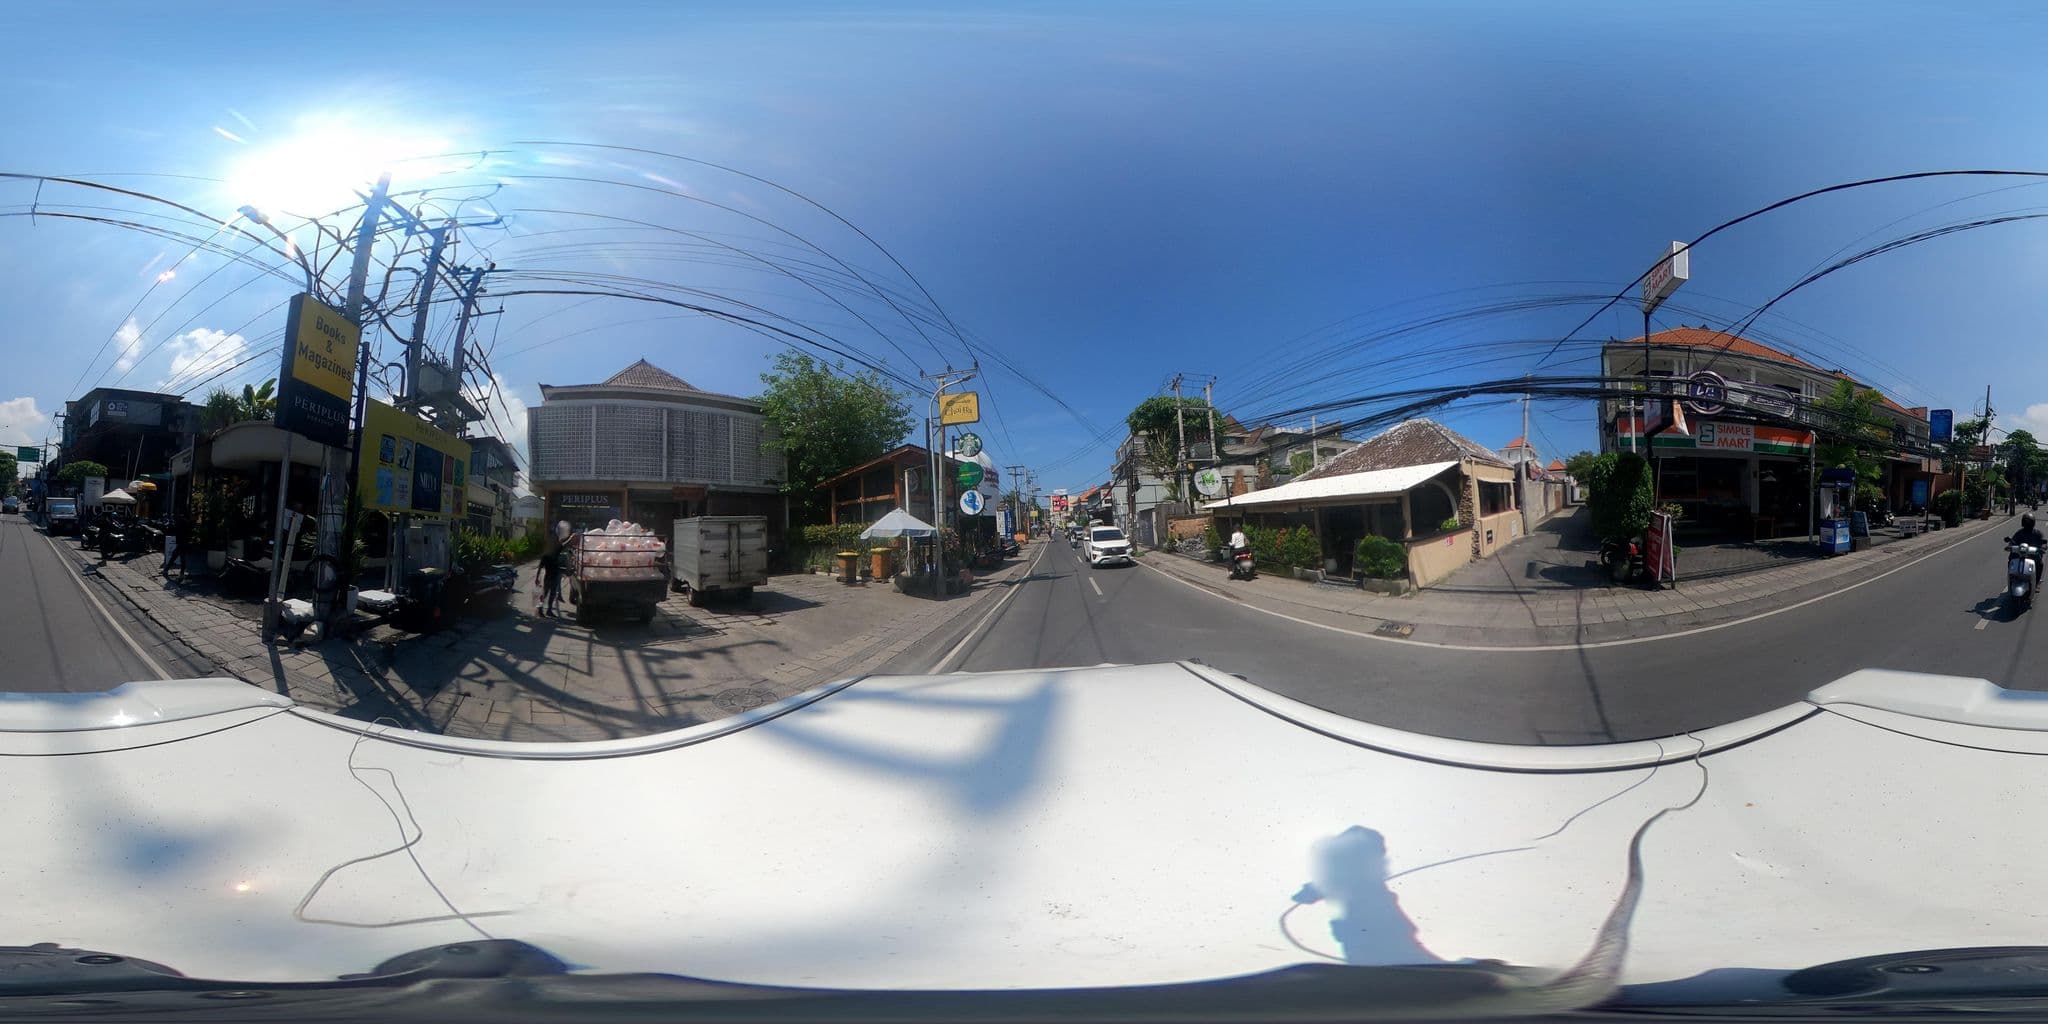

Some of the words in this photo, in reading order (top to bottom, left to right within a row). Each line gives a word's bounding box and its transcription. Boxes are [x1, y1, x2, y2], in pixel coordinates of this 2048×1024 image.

[1651, 261, 1673, 289] MART
[316, 315, 346, 345] Books
[325, 339, 333, 353] &
[298, 342, 352, 381] Magazines
[294, 395, 347, 425] PERIPLUS
[1717, 424, 1751, 436] SIMPLE
[1717, 437, 1751, 449] MART
[562, 495, 609, 504] PERIPLUS
